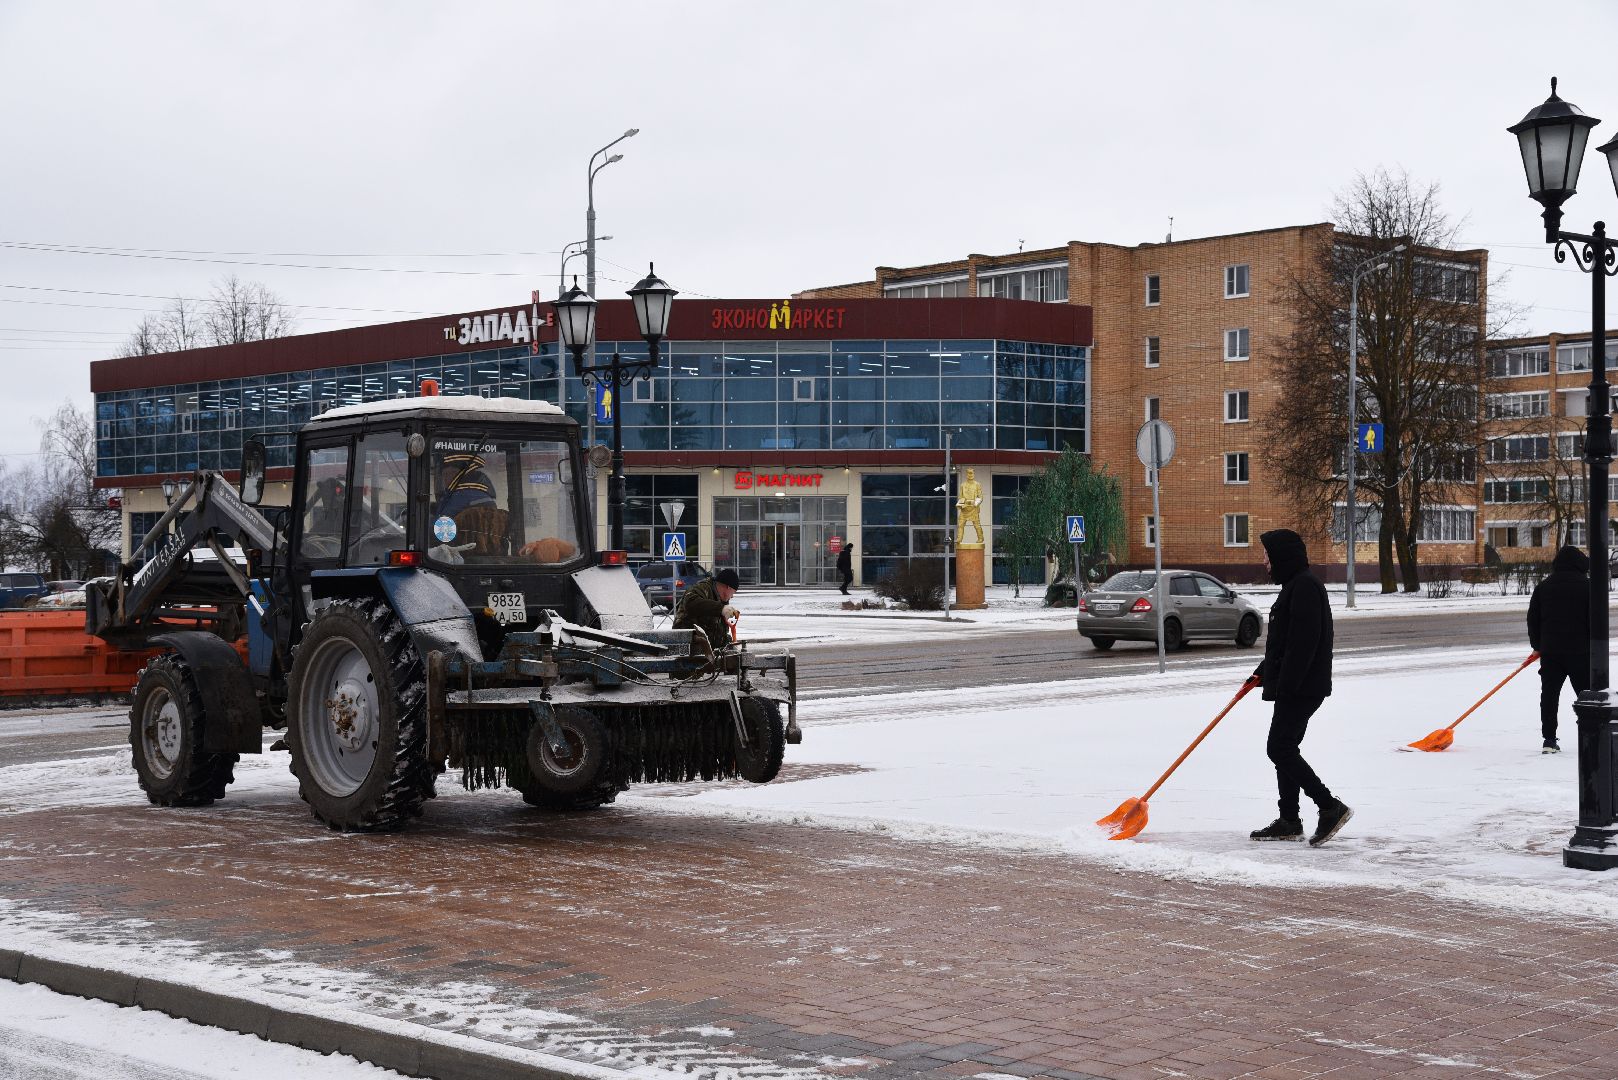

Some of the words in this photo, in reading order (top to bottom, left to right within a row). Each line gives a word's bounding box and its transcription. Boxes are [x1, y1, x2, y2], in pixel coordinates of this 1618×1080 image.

[546, 312, 554, 327] E
[712, 300, 846, 330] ЭКОНОМАРКЕТ
[443, 327, 457, 341] ТЦ
[458, 310, 531, 345] ЗАПАД
[532, 340, 539, 355] S
[434, 441, 467, 451] #НАШИ
[756, 473, 823, 487] МАГНИТ
[492, 594, 521, 607] 9832
[512, 611, 524, 621] 50
